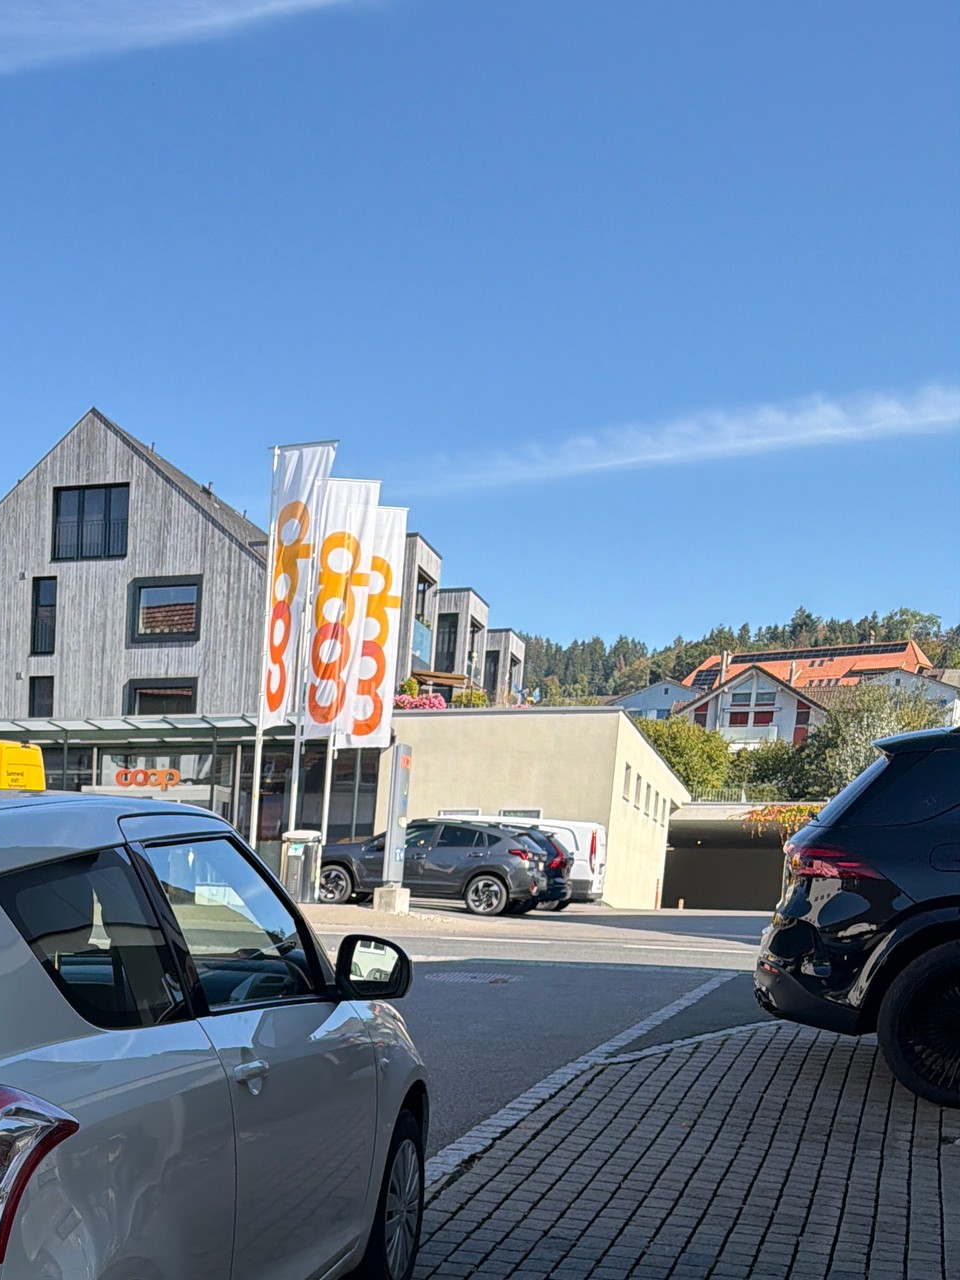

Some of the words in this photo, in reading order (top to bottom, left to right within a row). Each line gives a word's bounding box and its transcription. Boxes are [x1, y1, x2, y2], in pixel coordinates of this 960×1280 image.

[266, 500, 316, 712] coop
[308, 531, 371, 724] coop
[116, 768, 180, 791] coop
